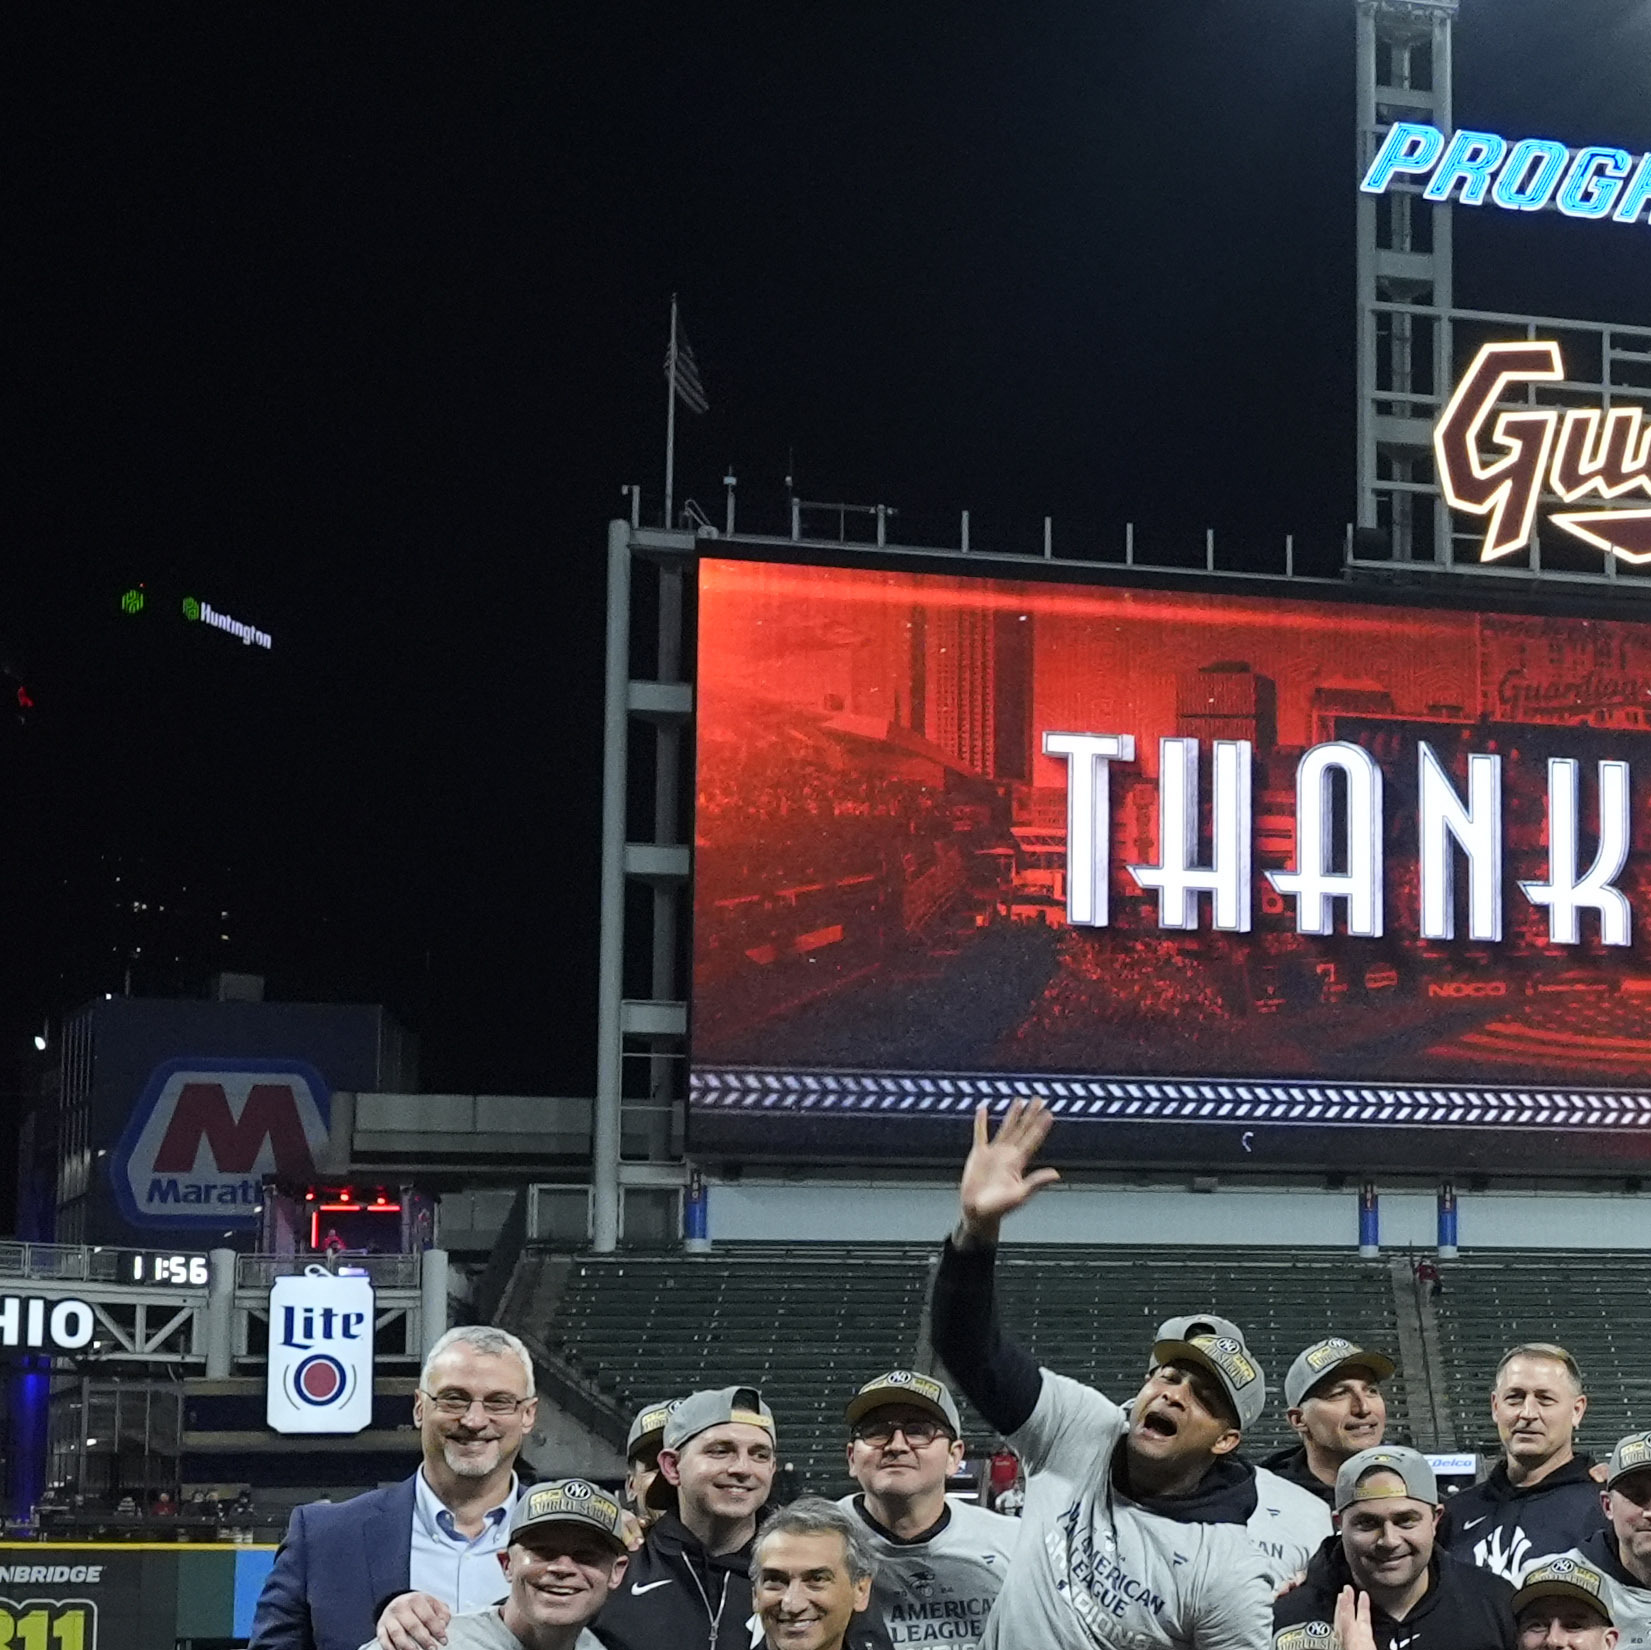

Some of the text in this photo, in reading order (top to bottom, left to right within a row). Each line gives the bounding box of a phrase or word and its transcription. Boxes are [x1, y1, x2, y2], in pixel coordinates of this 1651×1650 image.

[201, 603, 271, 649] Huntington
[1041, 730, 1631, 947] THANK
[149, 1179, 262, 1204] Marat
[280, 1305, 364, 1349] Lite
[1432, 1459, 1472, 1467] Delco
[1072, 1550, 1128, 1618] LEAGUE
[1081, 1530, 1166, 1616] AMERICAN
[890, 1598, 995, 1623] AMERICA
[892, 1621, 981, 1643] LEAGUE
